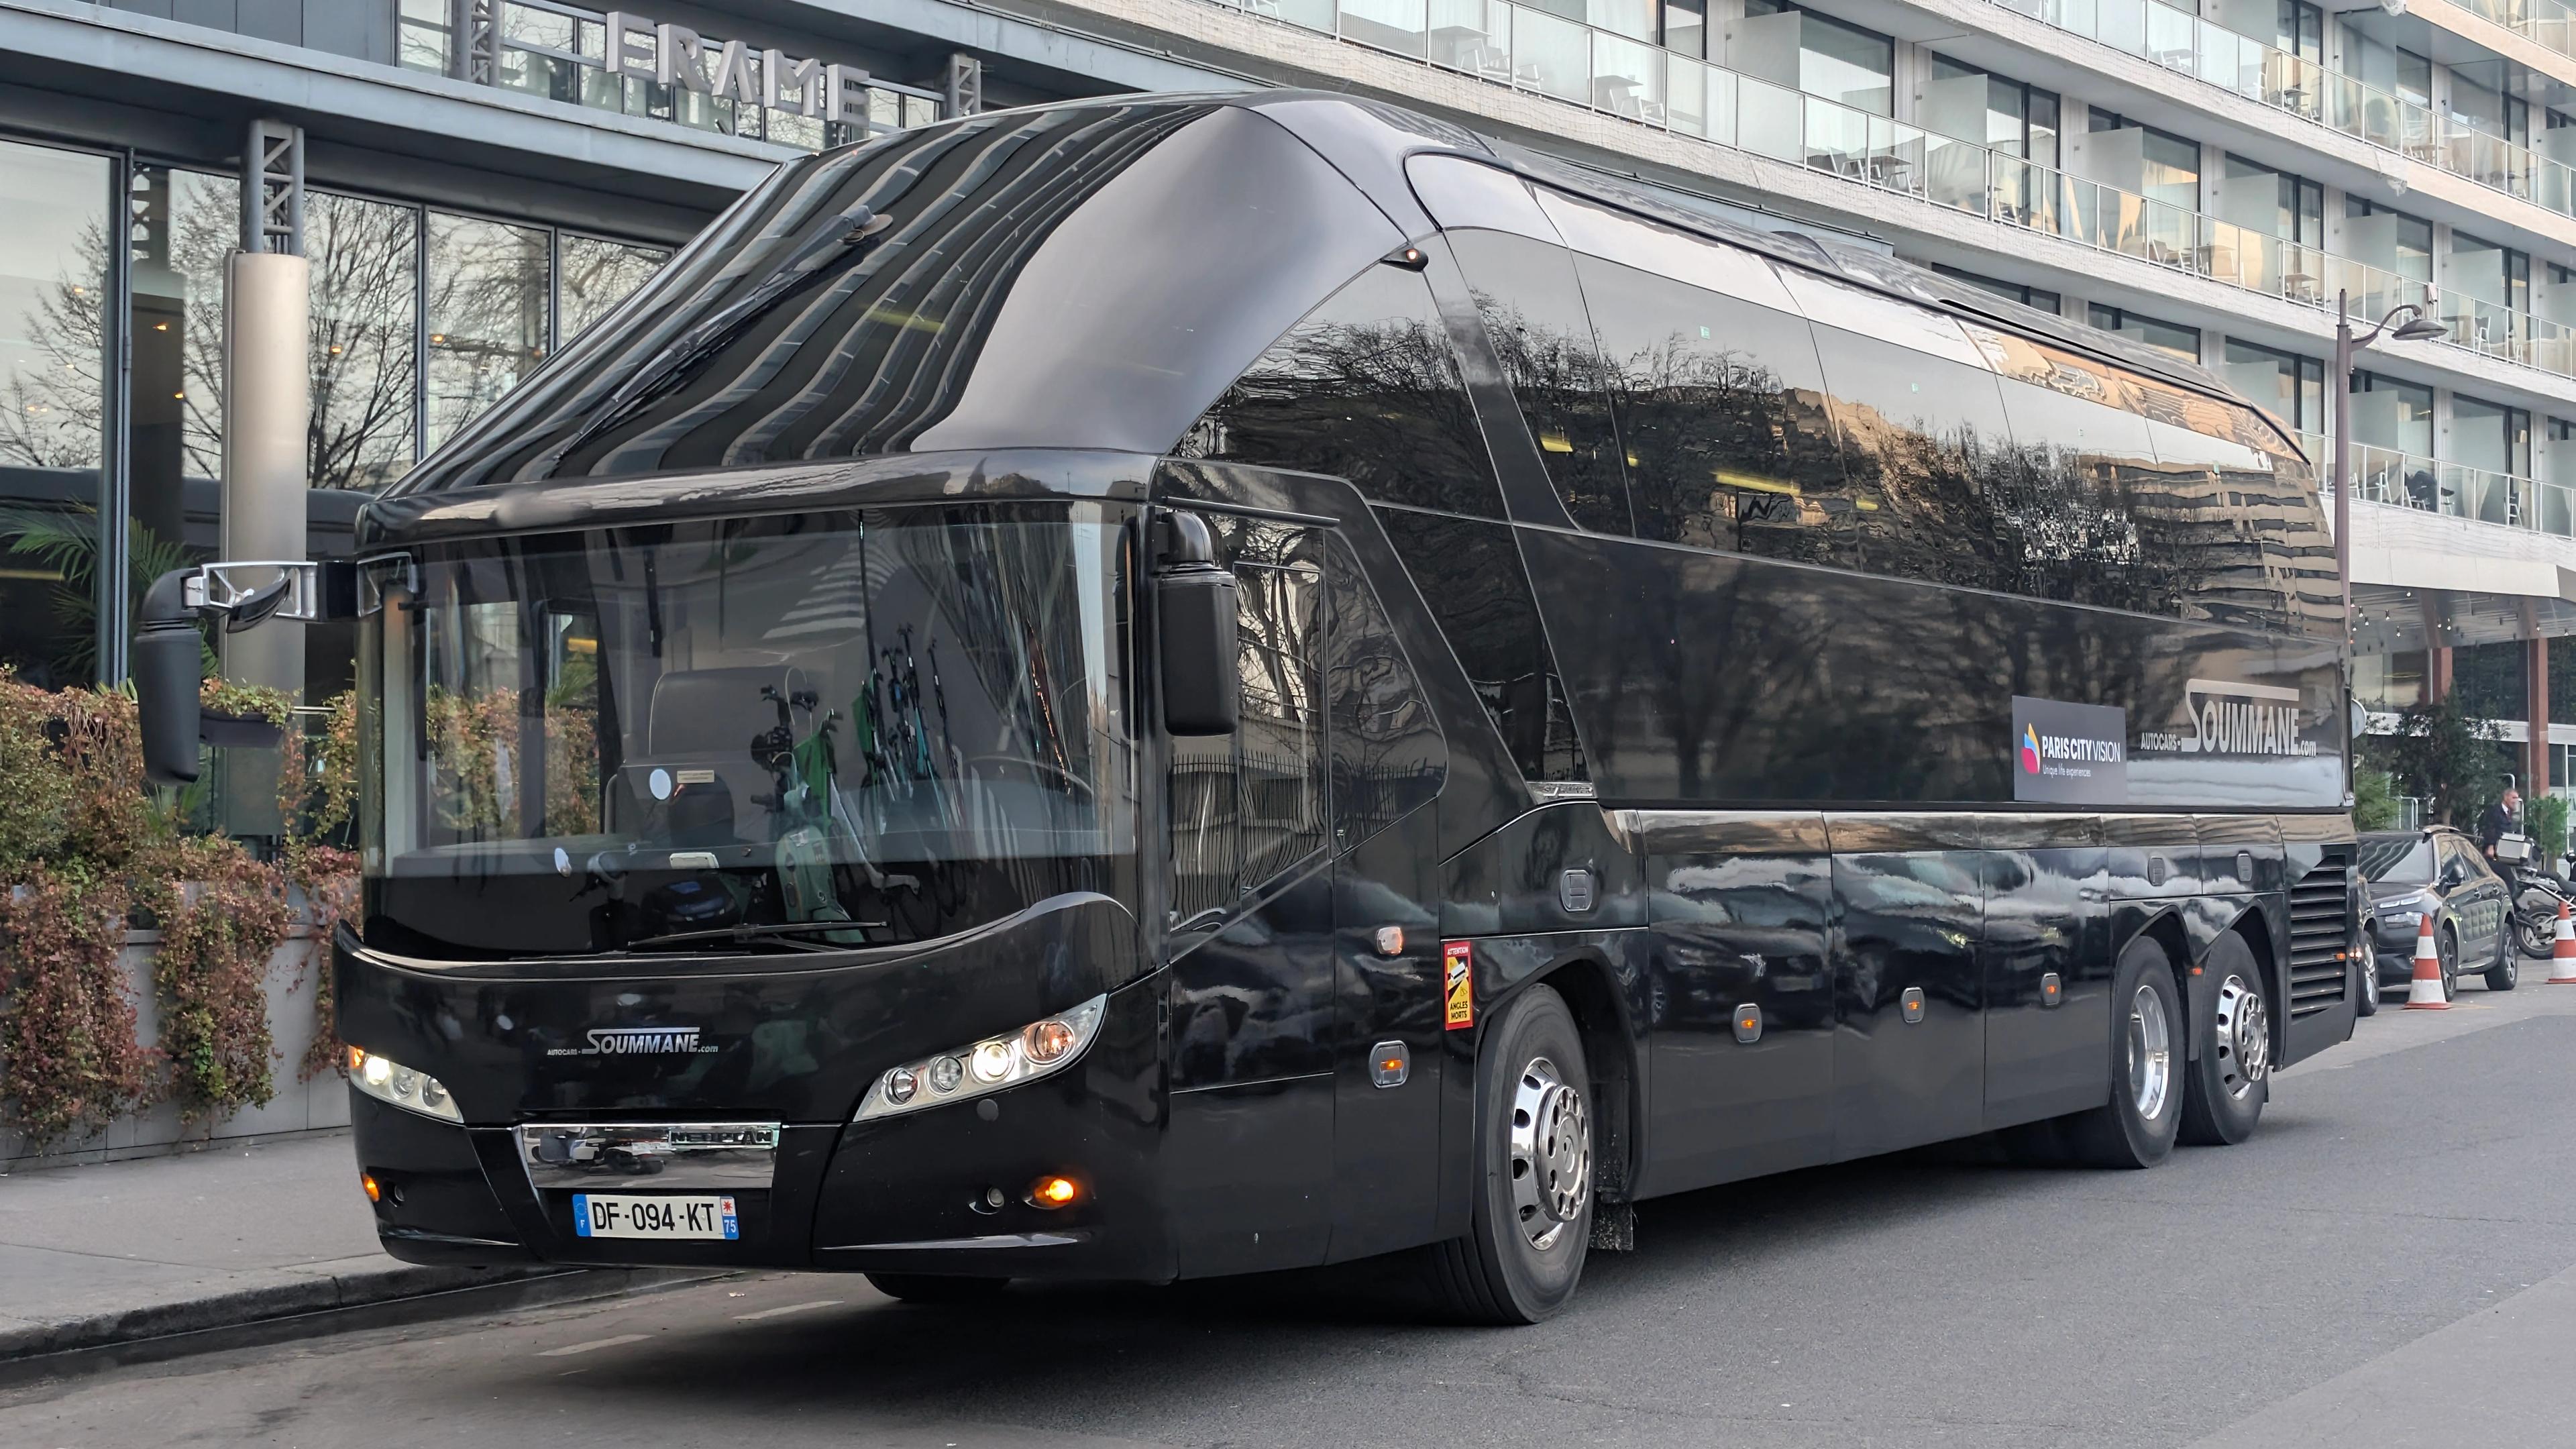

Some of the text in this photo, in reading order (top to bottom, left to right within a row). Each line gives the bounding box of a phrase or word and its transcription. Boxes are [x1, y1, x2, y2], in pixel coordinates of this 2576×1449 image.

[606, 11, 870, 127] FRAME
[2043, 764, 2057, 778] Unique
[2066, 767, 2091, 780] experiences
[1447, 947, 1468, 955] ATTENTION
[1450, 1001, 1468, 1010] ANGLES
[1451, 1011, 1467, 1020] MORTS
[580, 1201, 736, 1233] F DF-094-KT 75
